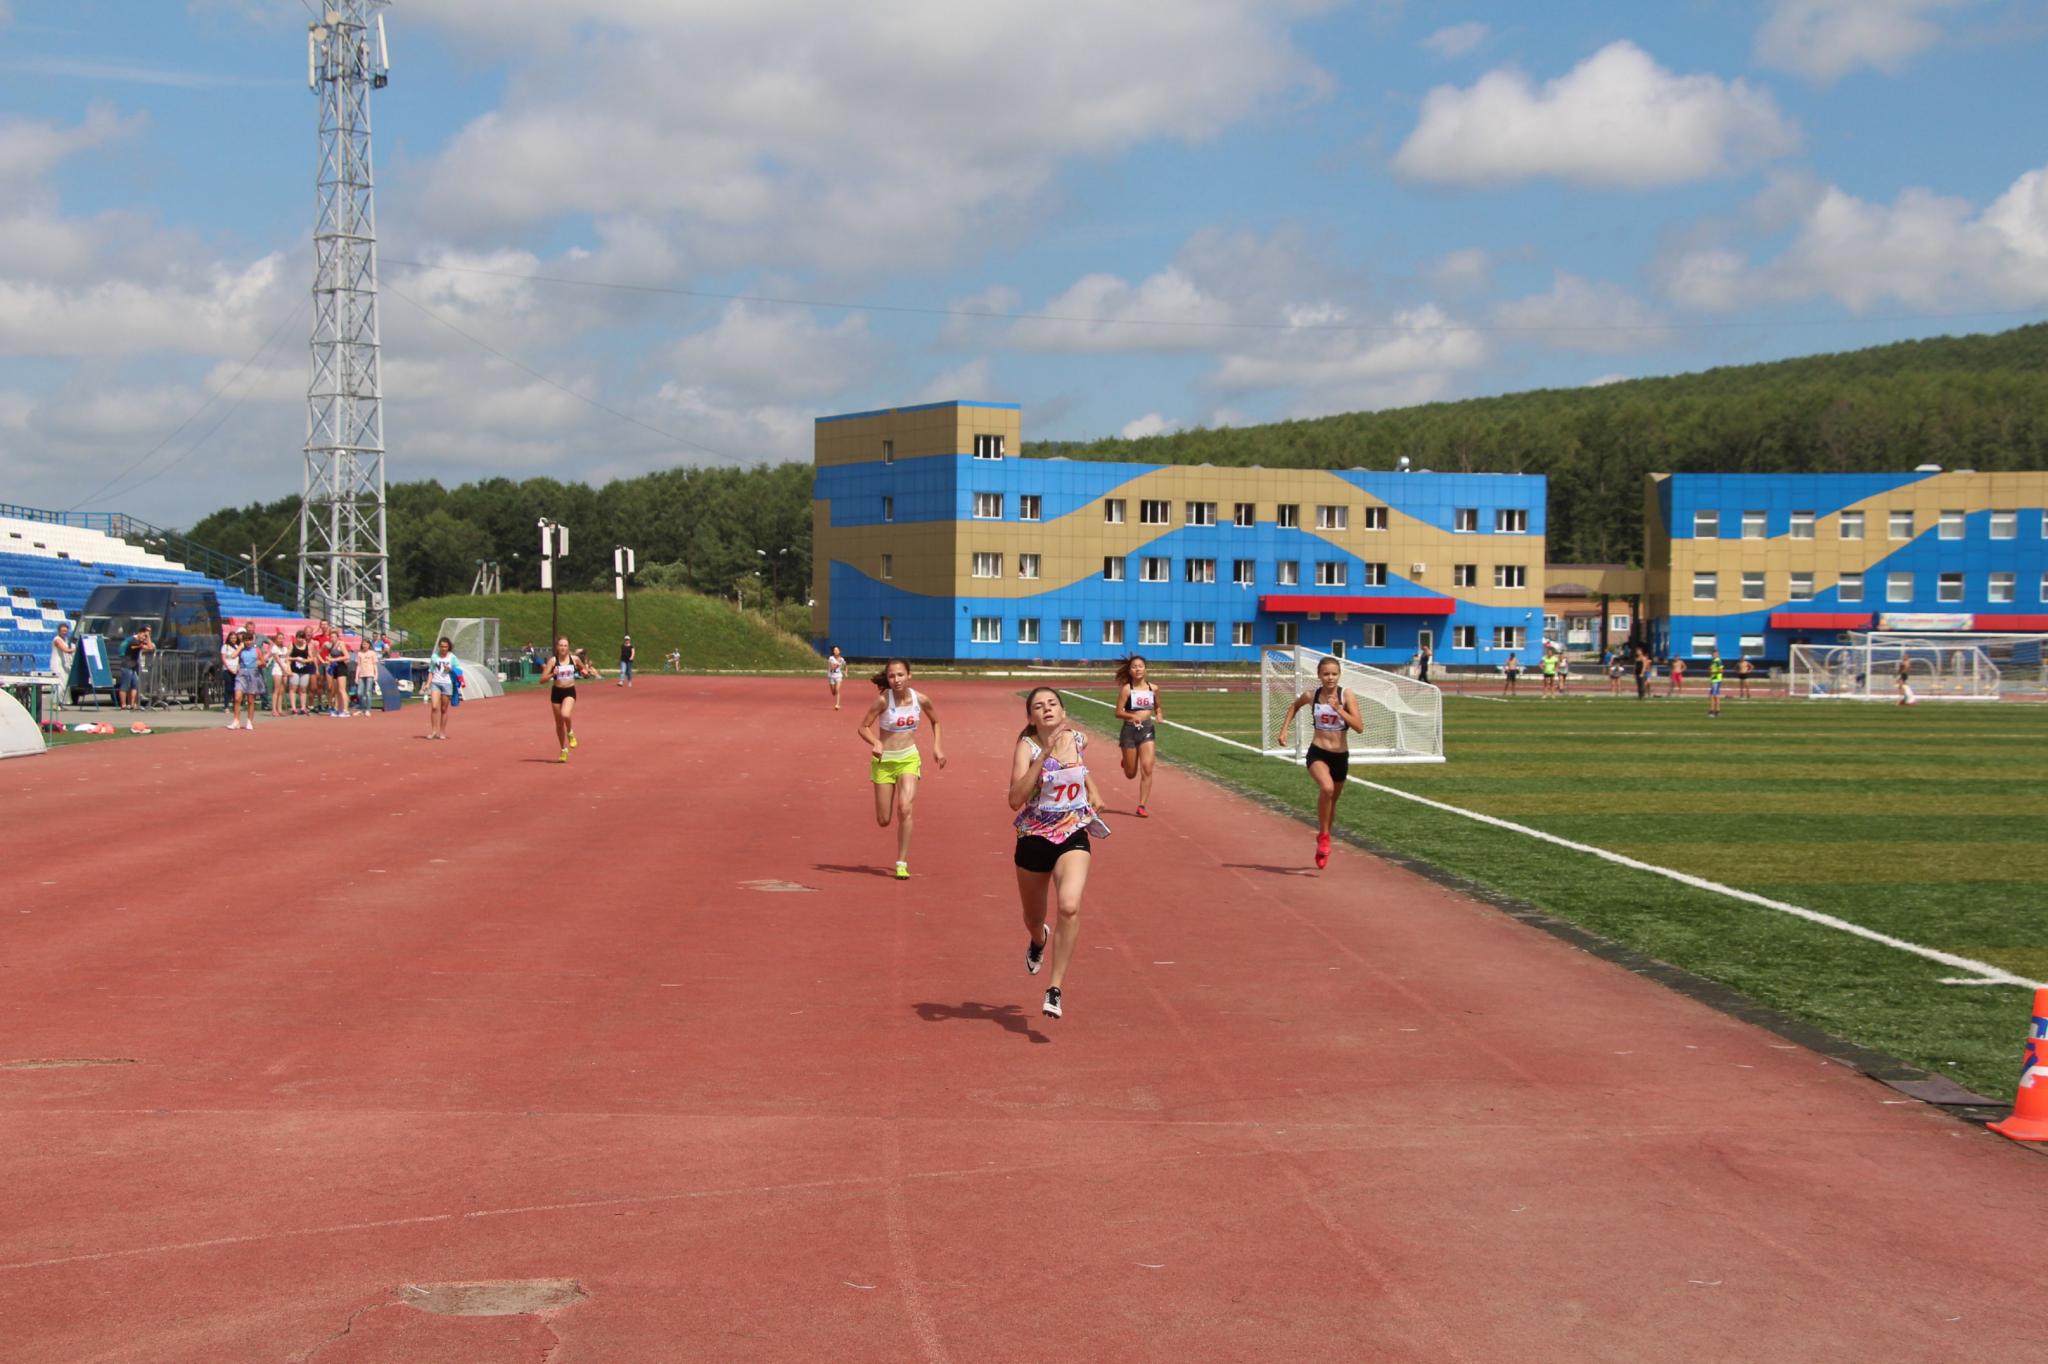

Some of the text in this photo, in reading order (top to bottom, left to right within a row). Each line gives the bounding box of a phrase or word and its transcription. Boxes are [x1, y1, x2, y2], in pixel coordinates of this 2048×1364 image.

[1136, 697, 1150, 706] 86
[896, 716, 915, 727] 66
[1321, 714, 1338, 725] 57
[1053, 783, 1081, 802] 70
